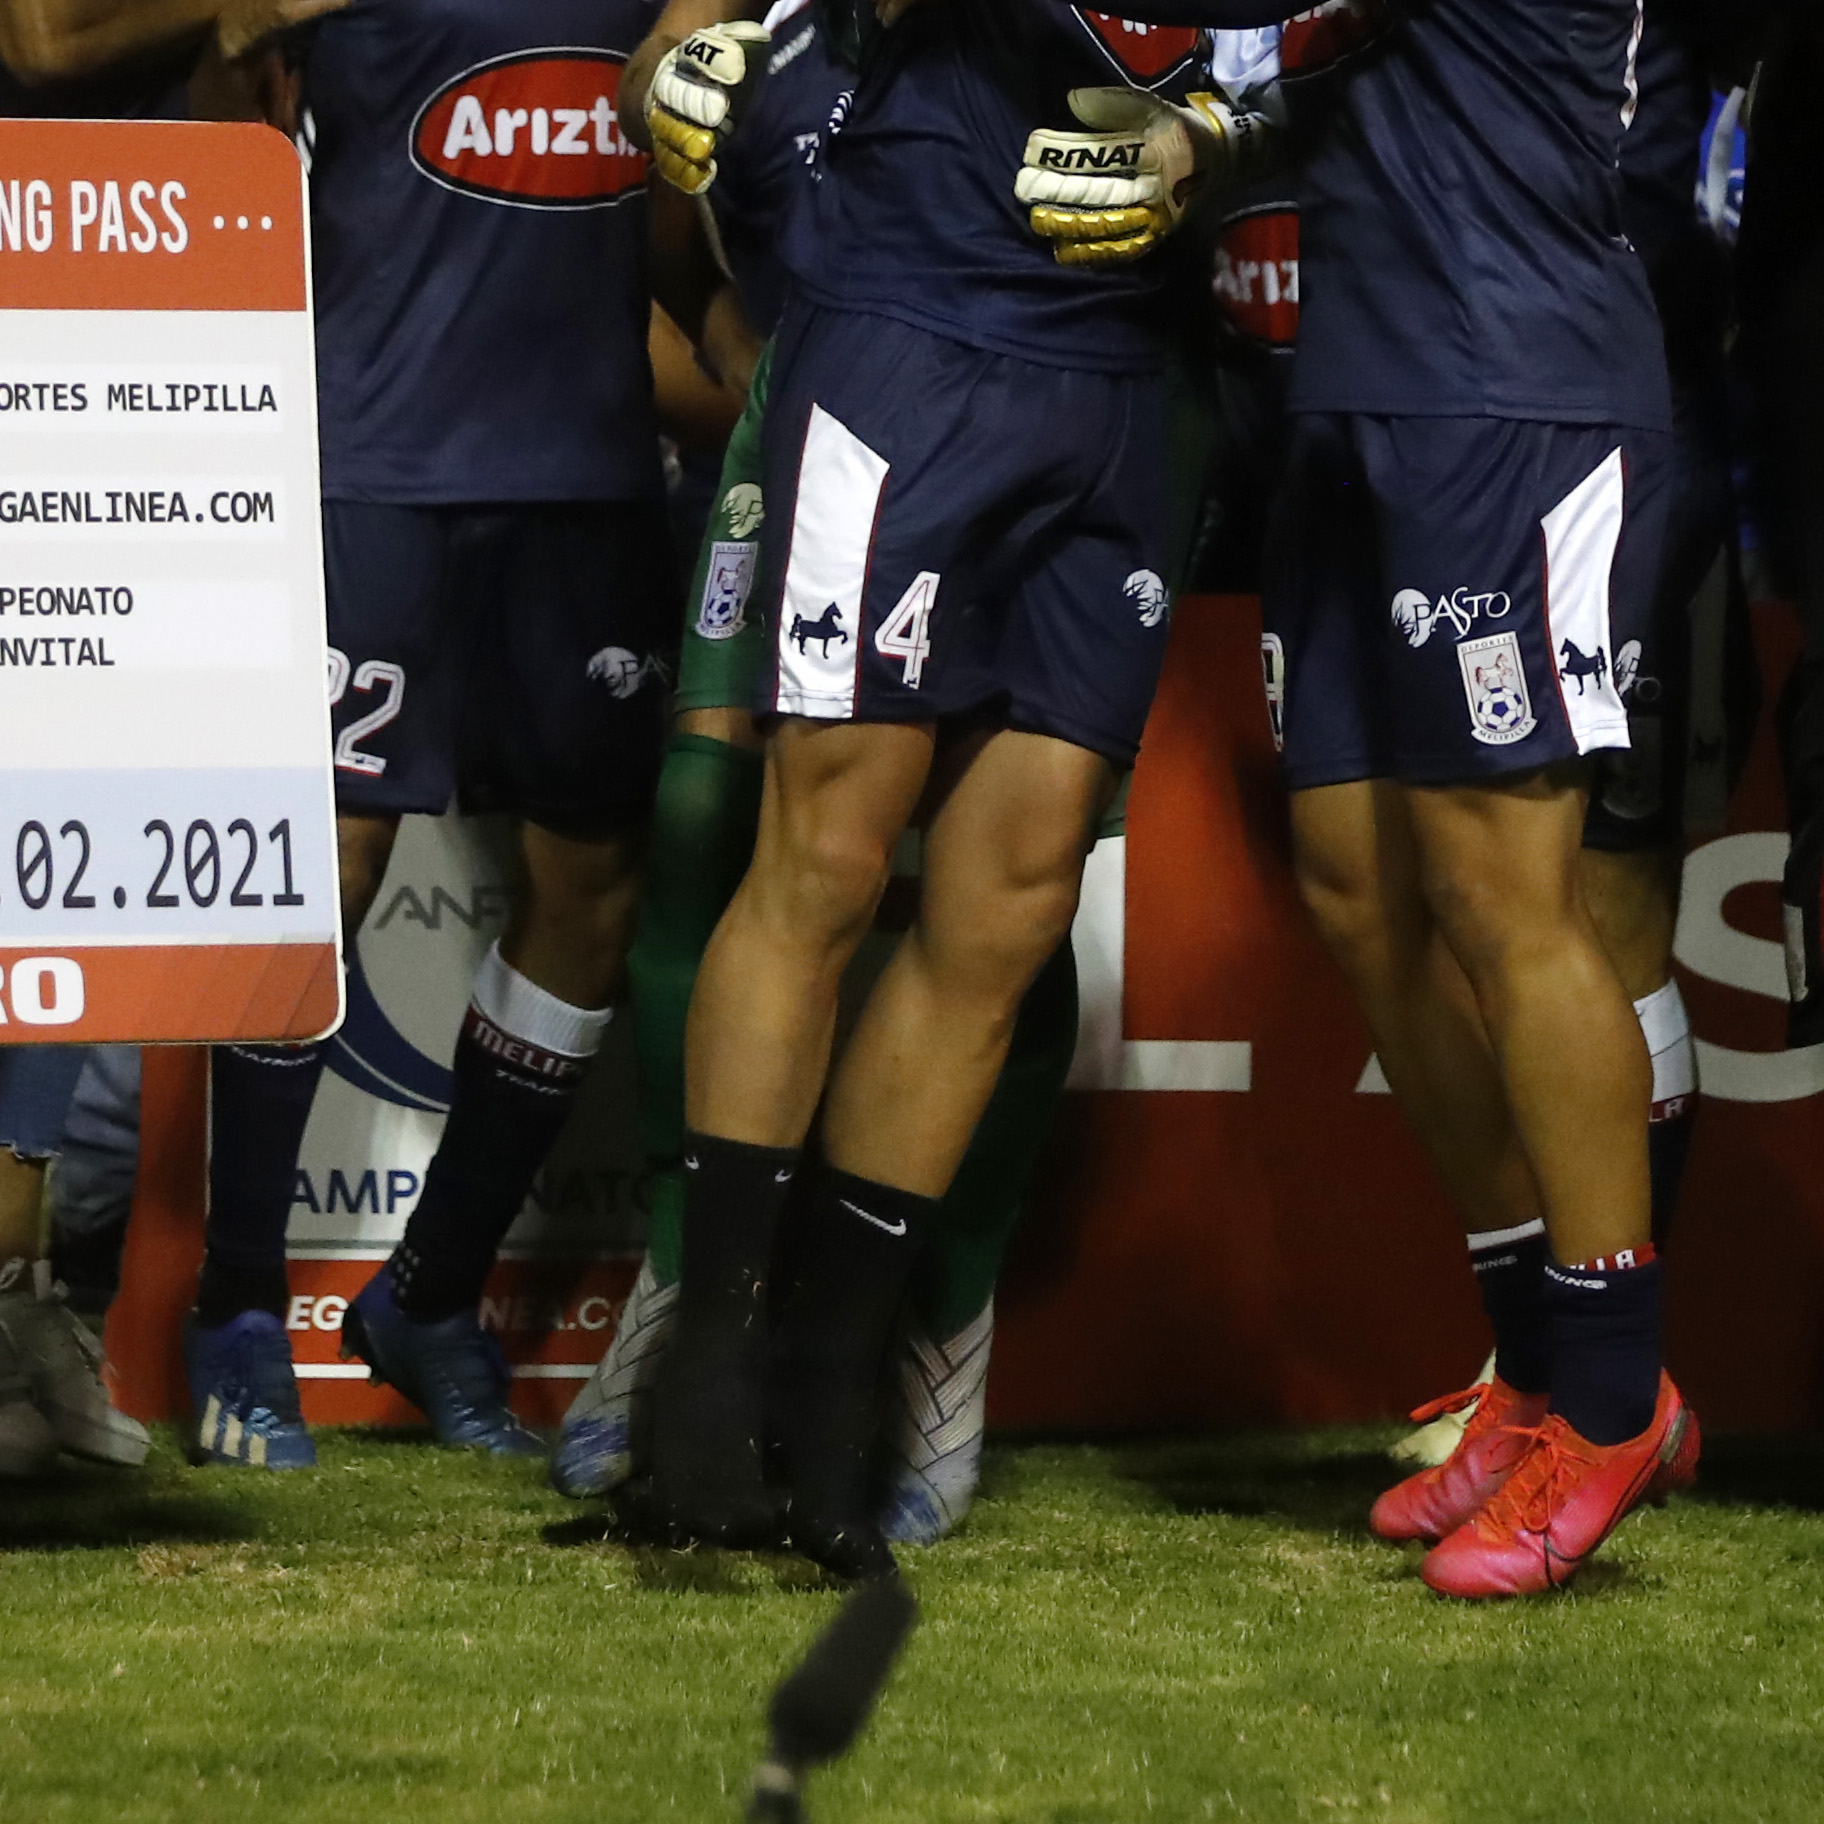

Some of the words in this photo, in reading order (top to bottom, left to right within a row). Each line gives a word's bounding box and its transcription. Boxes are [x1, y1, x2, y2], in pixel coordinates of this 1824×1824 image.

[442, 95, 638, 160] Arizt
[1039, 142, 1145, 169] RINAT
[70, 180, 189, 254] PASS
[1212, 248, 1300, 305] Ariz
[107, 383, 277, 412] MELIPILLA
[873, 570, 941, 690] 4
[1412, 586, 1511, 643] PASTO
[372, 884, 518, 931] ANF
